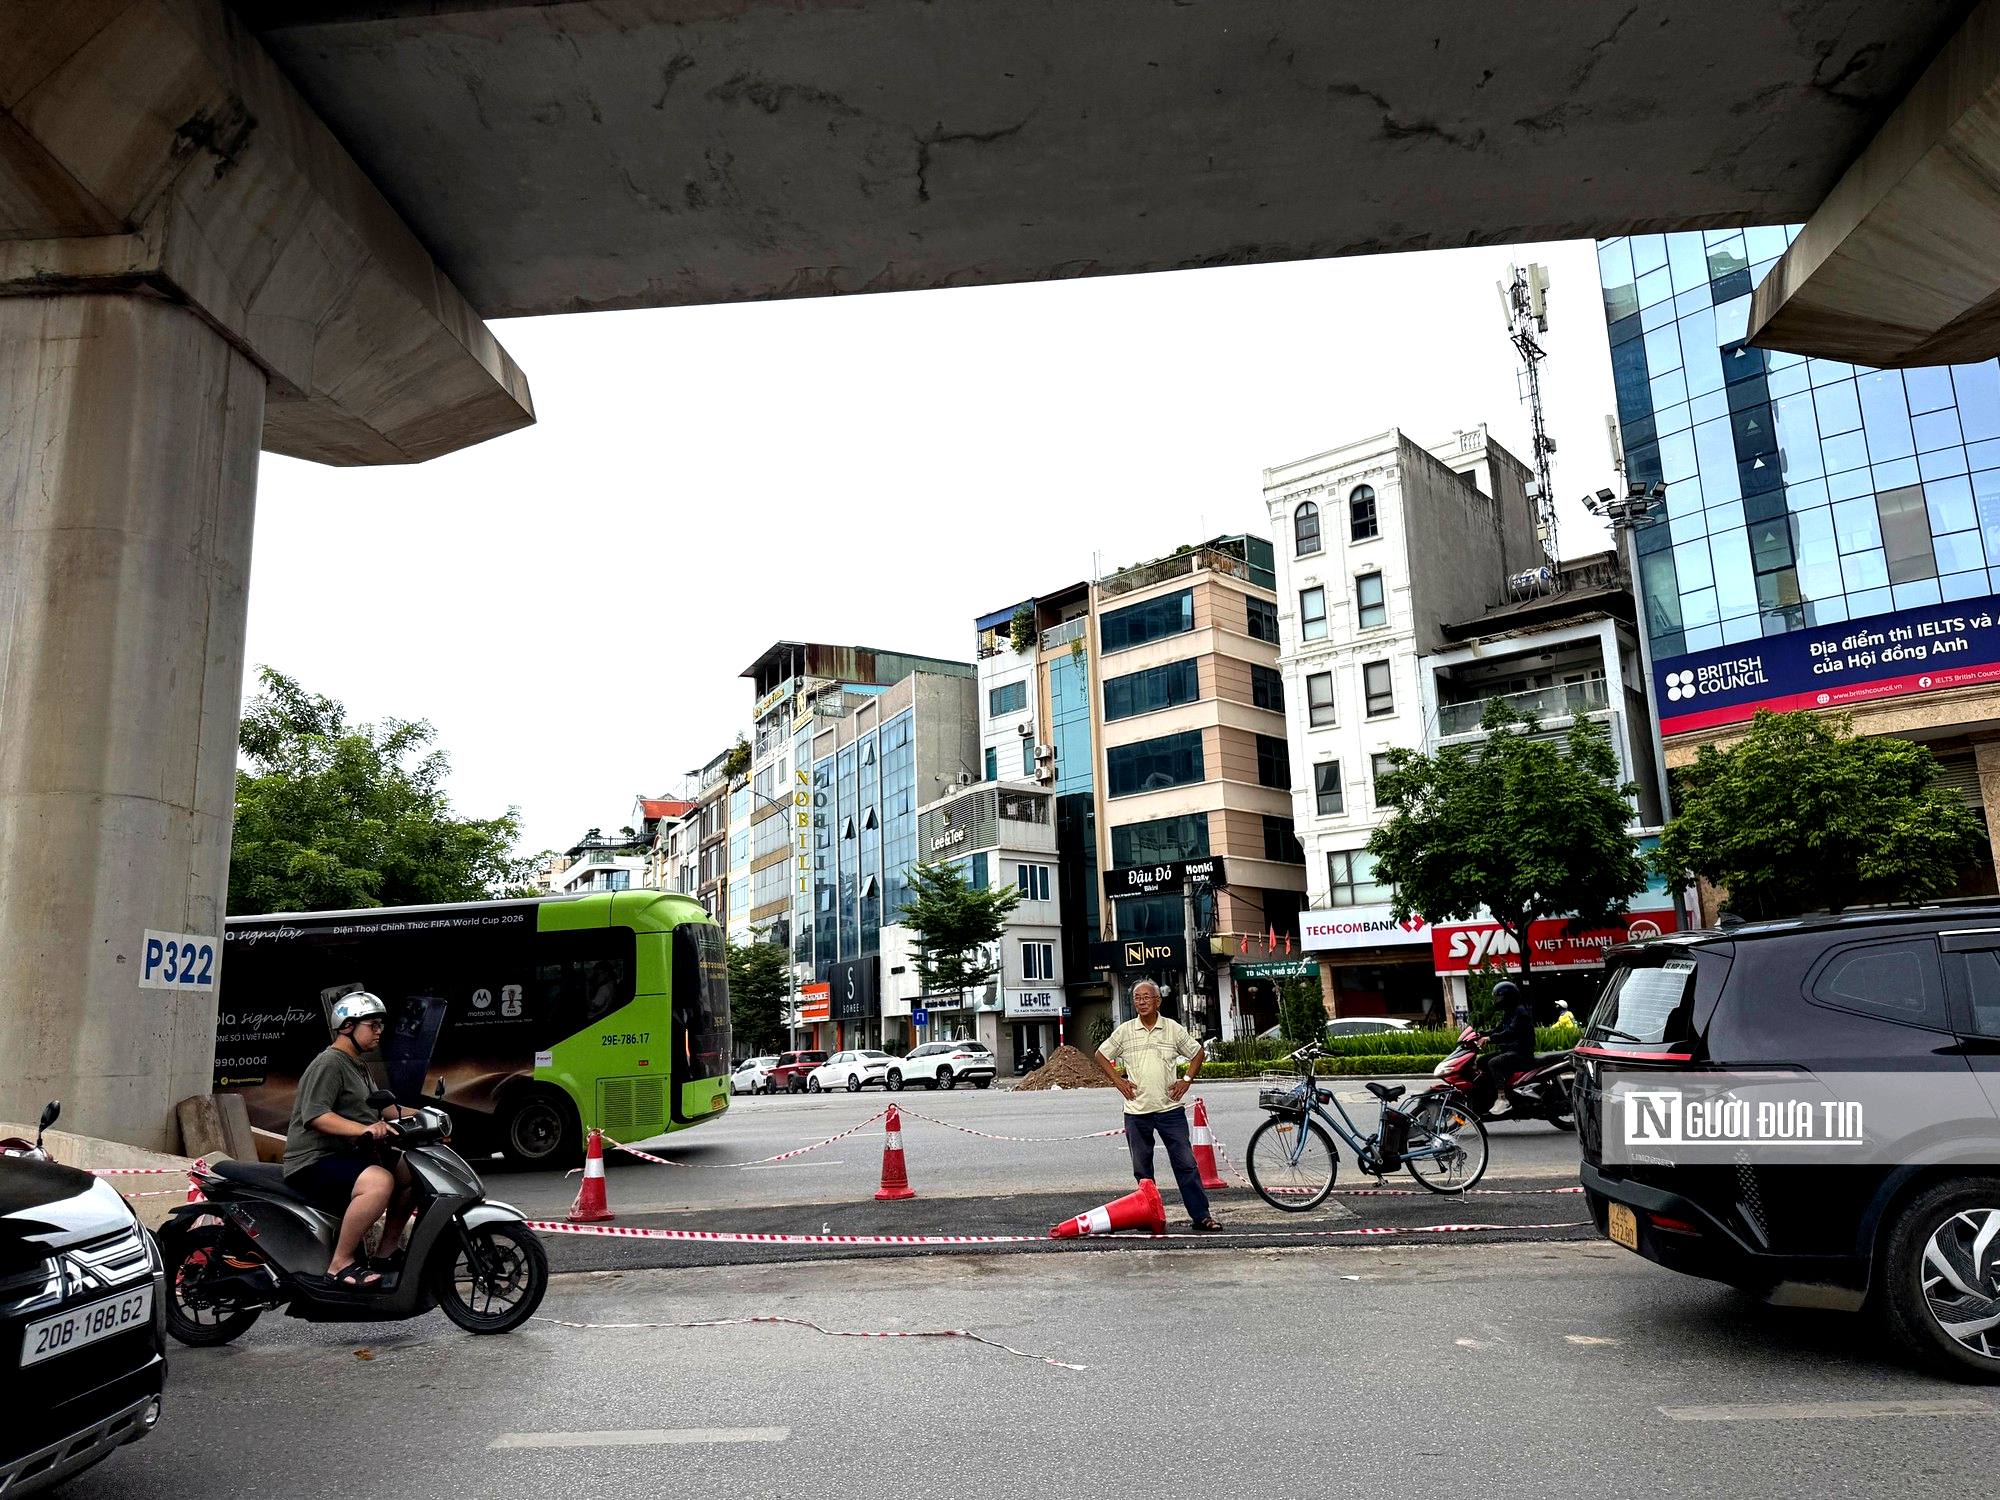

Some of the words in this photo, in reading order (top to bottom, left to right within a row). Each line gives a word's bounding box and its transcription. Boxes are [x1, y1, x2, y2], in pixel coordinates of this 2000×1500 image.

[1809, 641, 1838, 657] Địa
[1842, 629, 1885, 650] điểm
[1888, 625, 1913, 642] thi
[1917, 617, 1966, 638] IELTS
[1969, 612, 1992, 629] và
[1697, 655, 1762, 682] BRITISH
[1813, 657, 1844, 675] của
[1848, 651, 1877, 670] Hội
[1881, 643, 1928, 663] đồng
[1932, 637, 1969, 655] Anh
[1698, 669, 1769, 695] COUNCIL
[1954, 672, 1977, 682] British
[1832, 683, 1903, 700] www.britishcouncil.vn
[795, 769, 811, 893] NOBILI
[1128, 869, 1153, 887] Đậu
[1155, 864, 1172, 881] Đỏ
[430, 919, 451, 928] FIFA
[453, 917, 480, 927] World
[482, 916, 500, 926] Cup
[501, 914, 524, 924] 2026
[1306, 920, 1398, 936] TECHCOMBANK
[238, 924, 305, 946] signature
[1448, 929, 1521, 966] SYM
[1534, 937, 1564, 952] VIỆT
[1566, 936, 1613, 949] THANH
[144, 938, 214, 985] P322
[240, 1005, 317, 1031] signature
[601, 1032, 650, 1046] 29E-786.17
[34, 1295, 143, 1355] 20B-188.62
